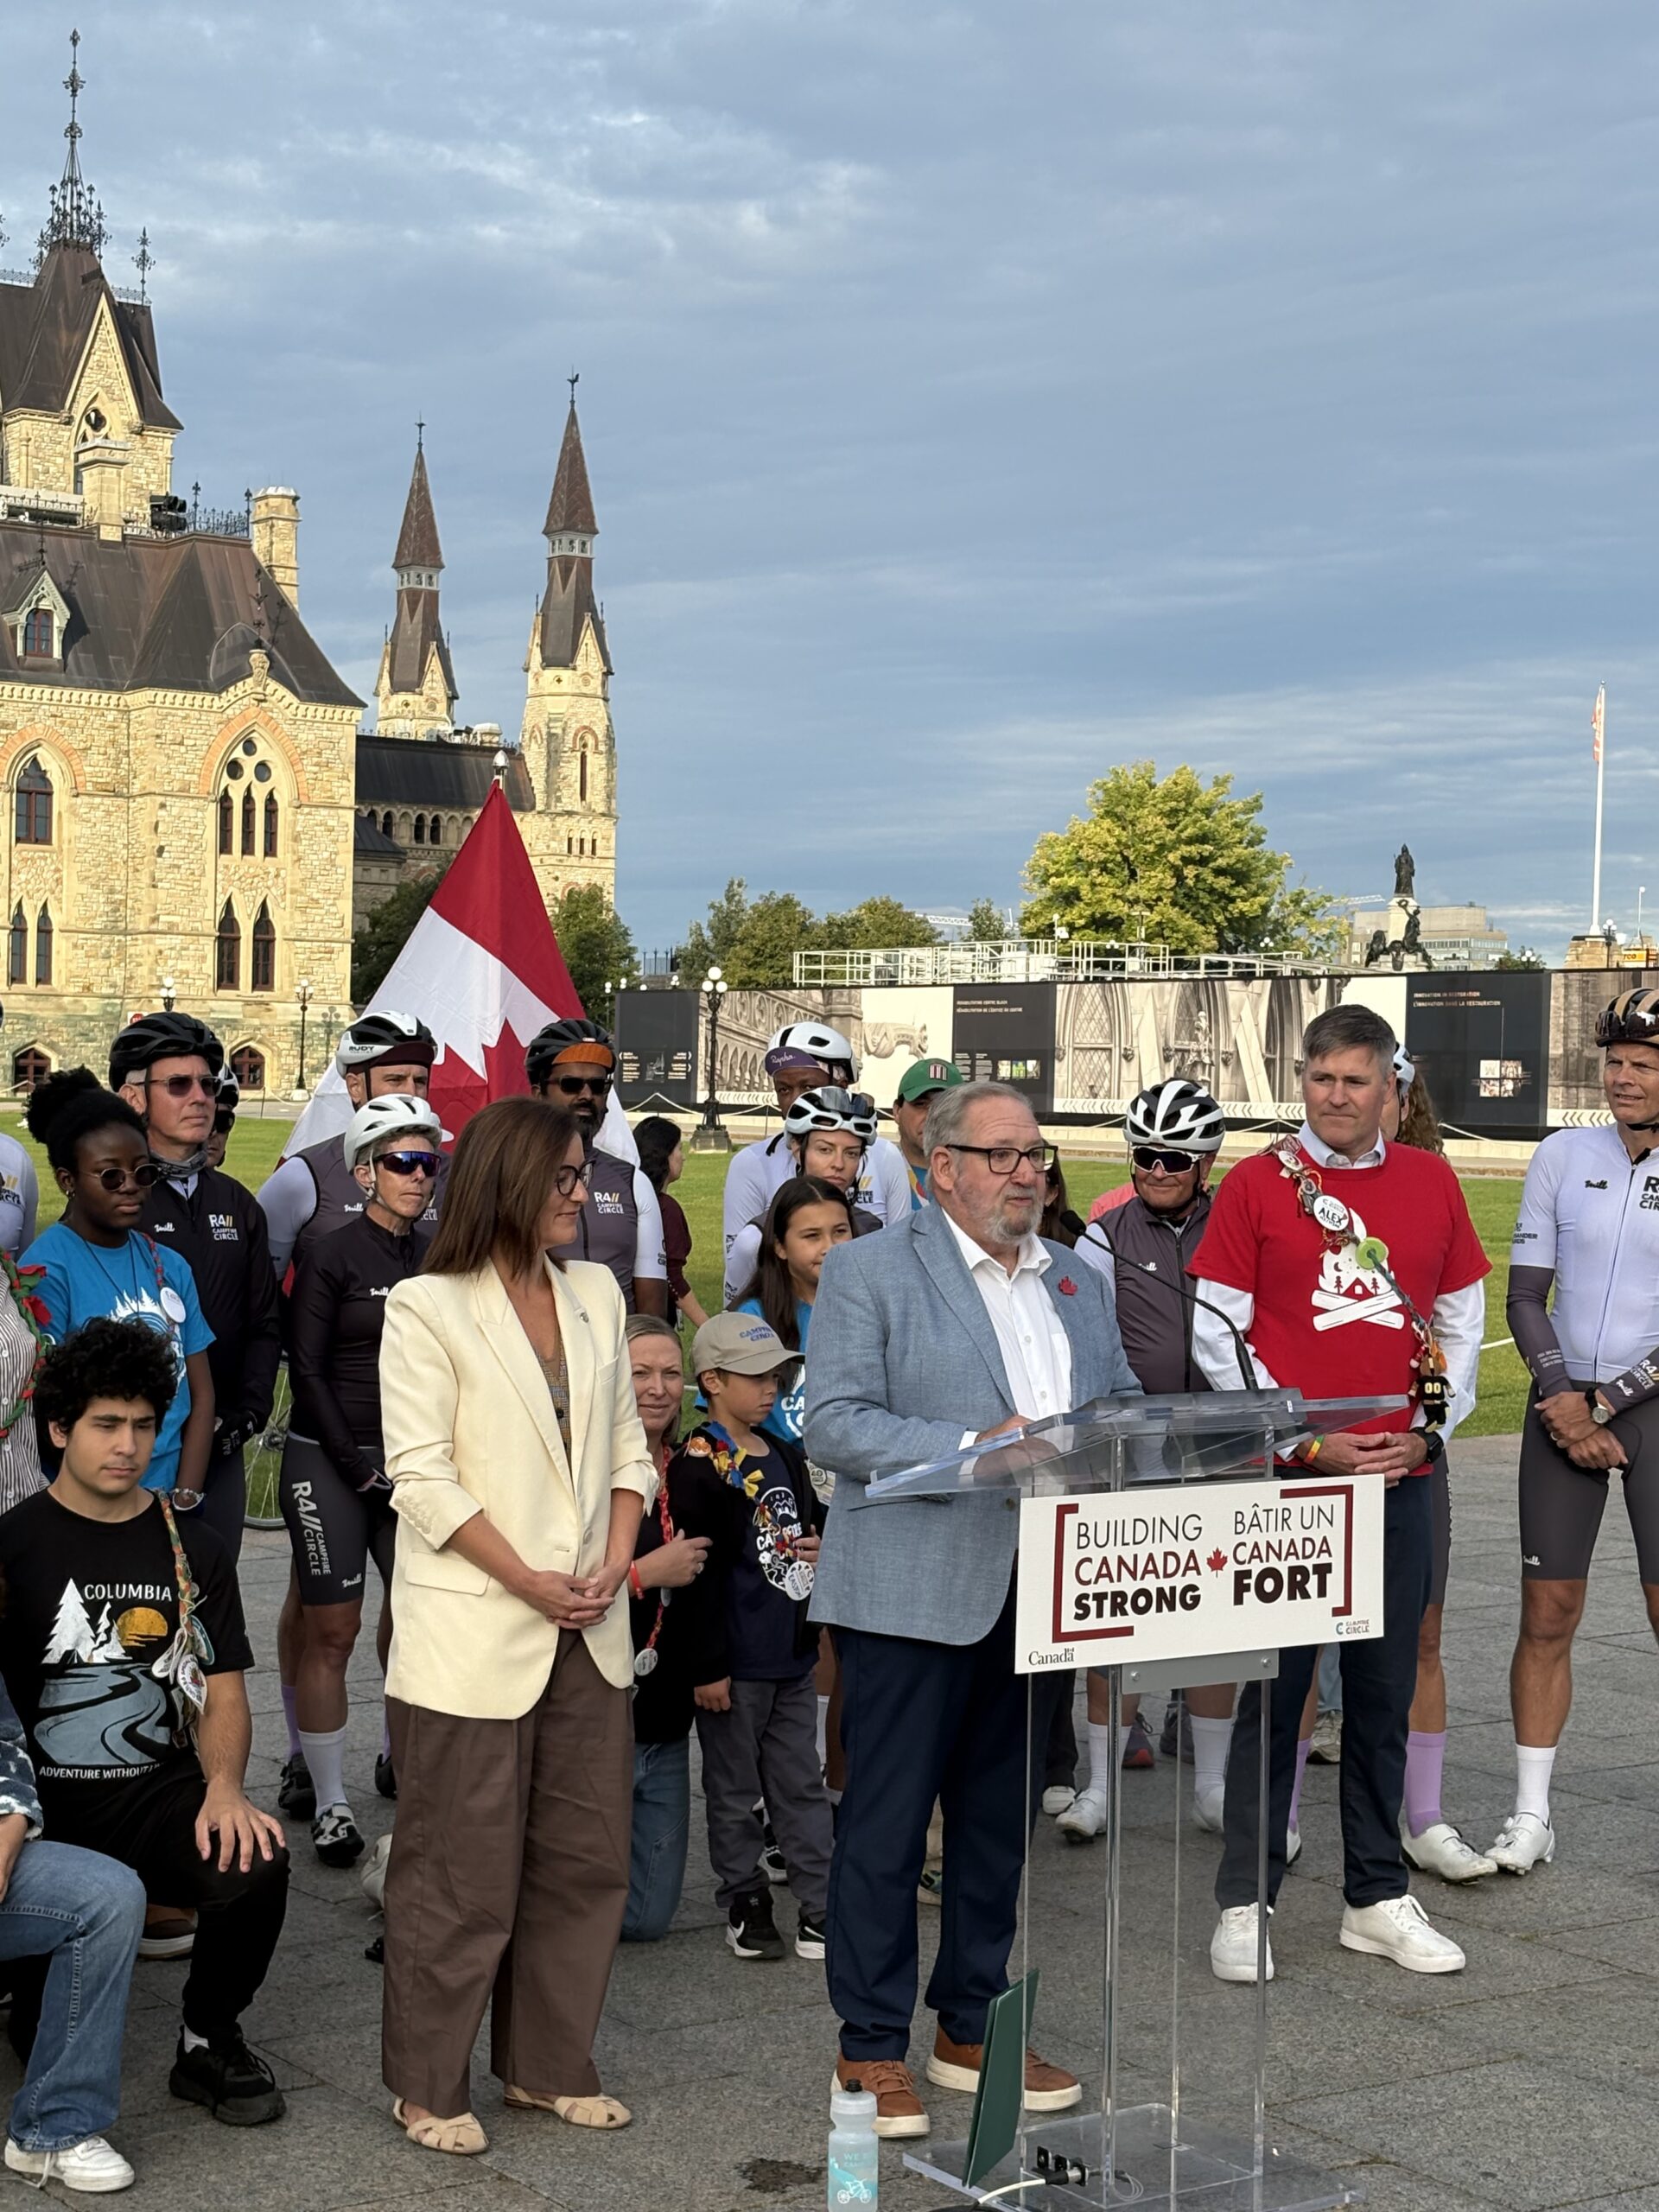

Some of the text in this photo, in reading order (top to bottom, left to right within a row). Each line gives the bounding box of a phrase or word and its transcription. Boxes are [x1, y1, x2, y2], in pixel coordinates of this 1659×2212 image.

[770, 1051, 795, 1066] Rapha
[1425, 1382, 1442, 1394] 00
[1076, 1513, 1203, 1550] BUILDING
[1234, 1503, 1334, 1535] BÂTIR UN
[303, 1529, 321, 1576] CIRCLE
[316, 1532, 332, 1574] CAMPFIRE
[1232, 1535, 1332, 1567] CANADA
[1074, 1549, 1202, 1586] CANADA
[84, 1583, 173, 1602] COLUMBIA
[1233, 1562, 1333, 1606] FORT
[1073, 1583, 1202, 1621] STRONG
[1345, 1625, 1370, 1634] CIRCLE
[1028, 1647, 1075, 1666] Canada
[40, 1765, 101, 1779] ADVENTURE
